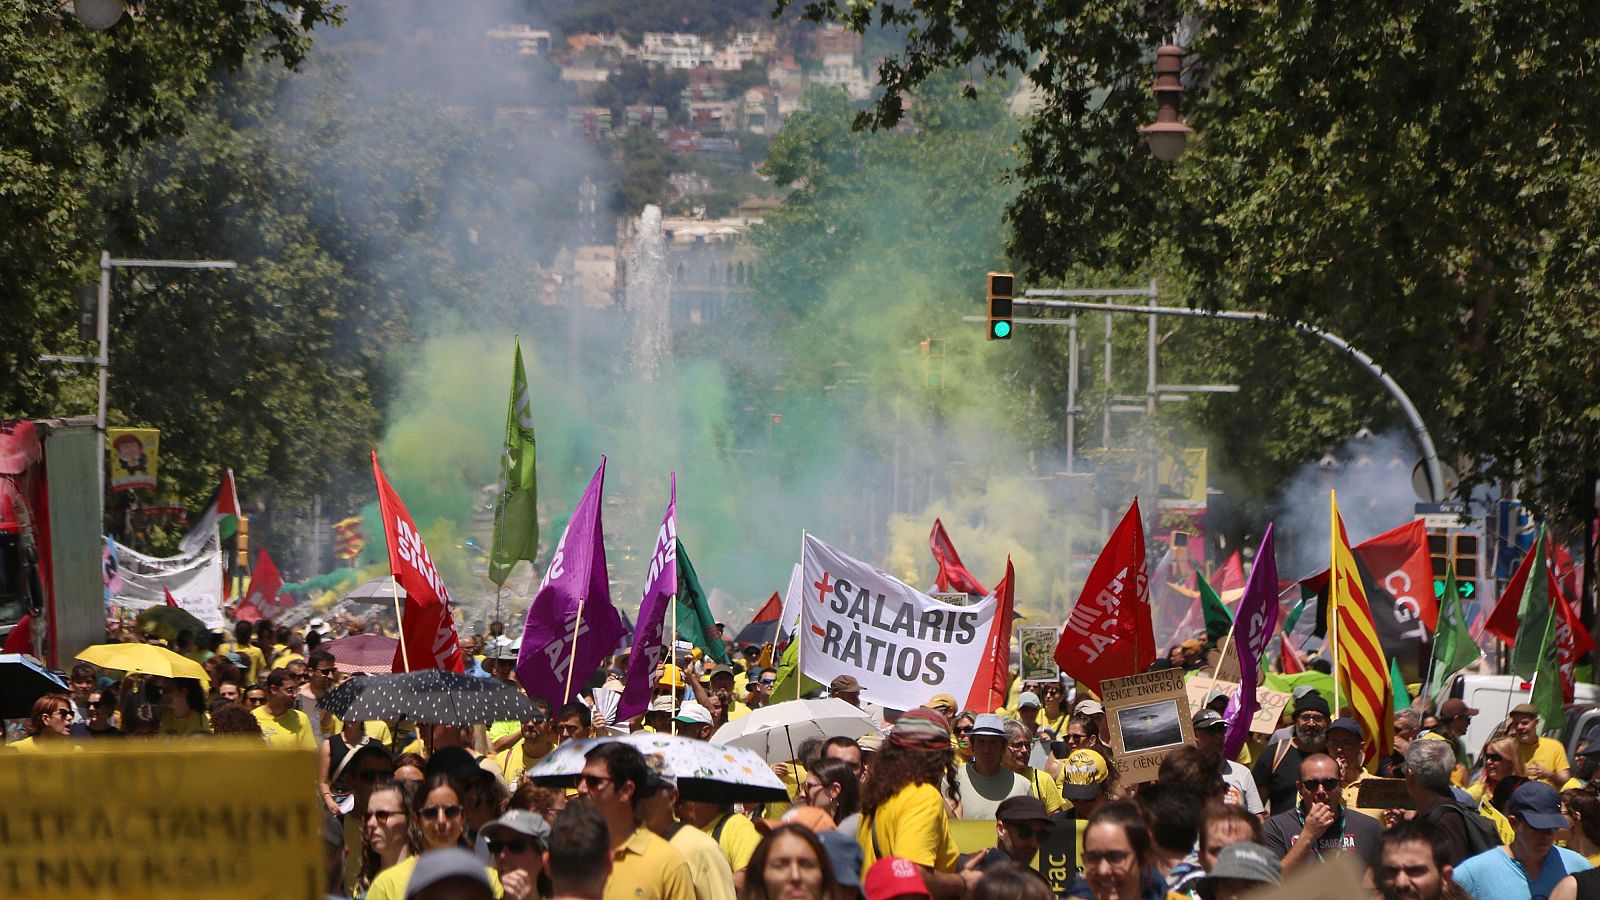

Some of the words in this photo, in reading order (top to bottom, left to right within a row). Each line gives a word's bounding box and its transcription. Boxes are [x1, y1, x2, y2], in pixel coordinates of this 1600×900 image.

[1384, 569, 1428, 643] CGT
[1101, 681, 1117, 691] LA
[1105, 688, 1134, 701] SENSE
[1137, 675, 1184, 697] INVERSIÓ
[1117, 758, 1130, 773] ÉS
[1133, 753, 1163, 769] CIÈNCI
